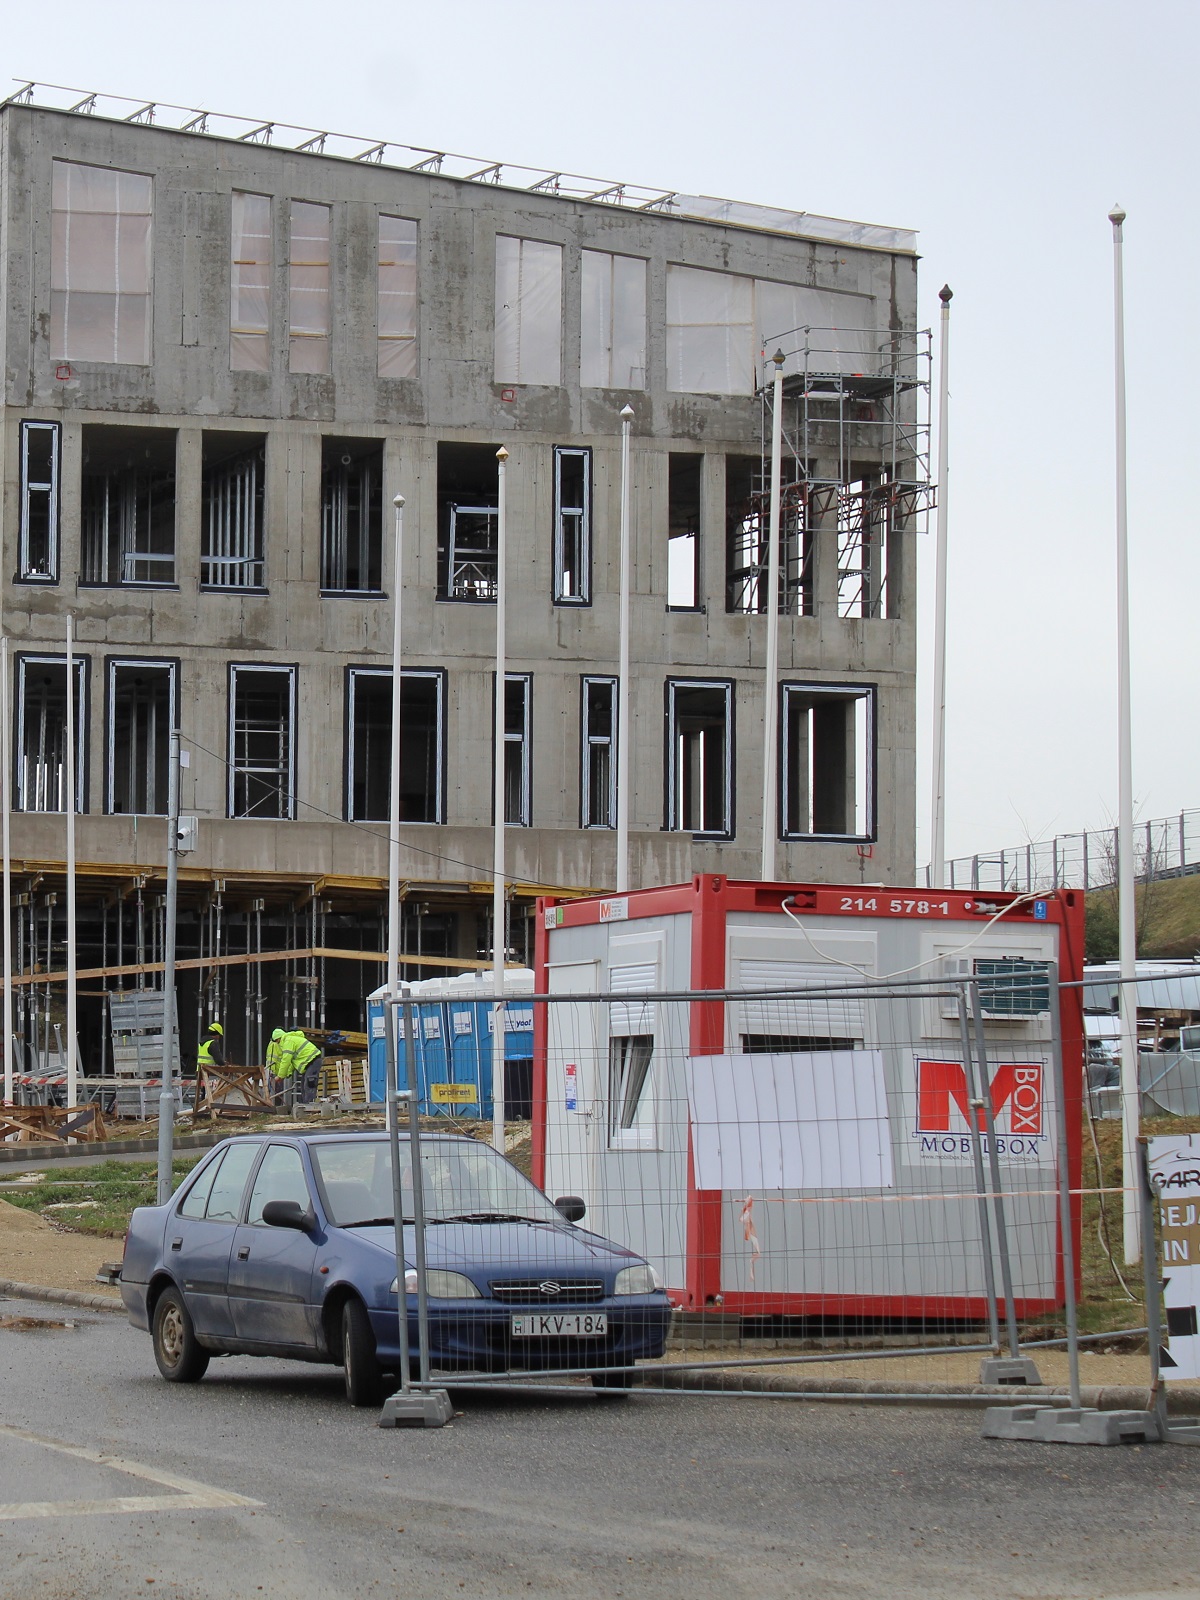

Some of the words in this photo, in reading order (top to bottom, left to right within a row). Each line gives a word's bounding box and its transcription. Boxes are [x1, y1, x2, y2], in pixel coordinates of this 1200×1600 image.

[840, 897, 877, 911] 214
[889, 899, 949, 915] 578-1
[516, 1018, 532, 1028] yoo!
[1013, 1068, 1039, 1130] BOX
[920, 1137, 1039, 1155] MOBLBOX
[531, 1315, 604, 1334] IKV-184
